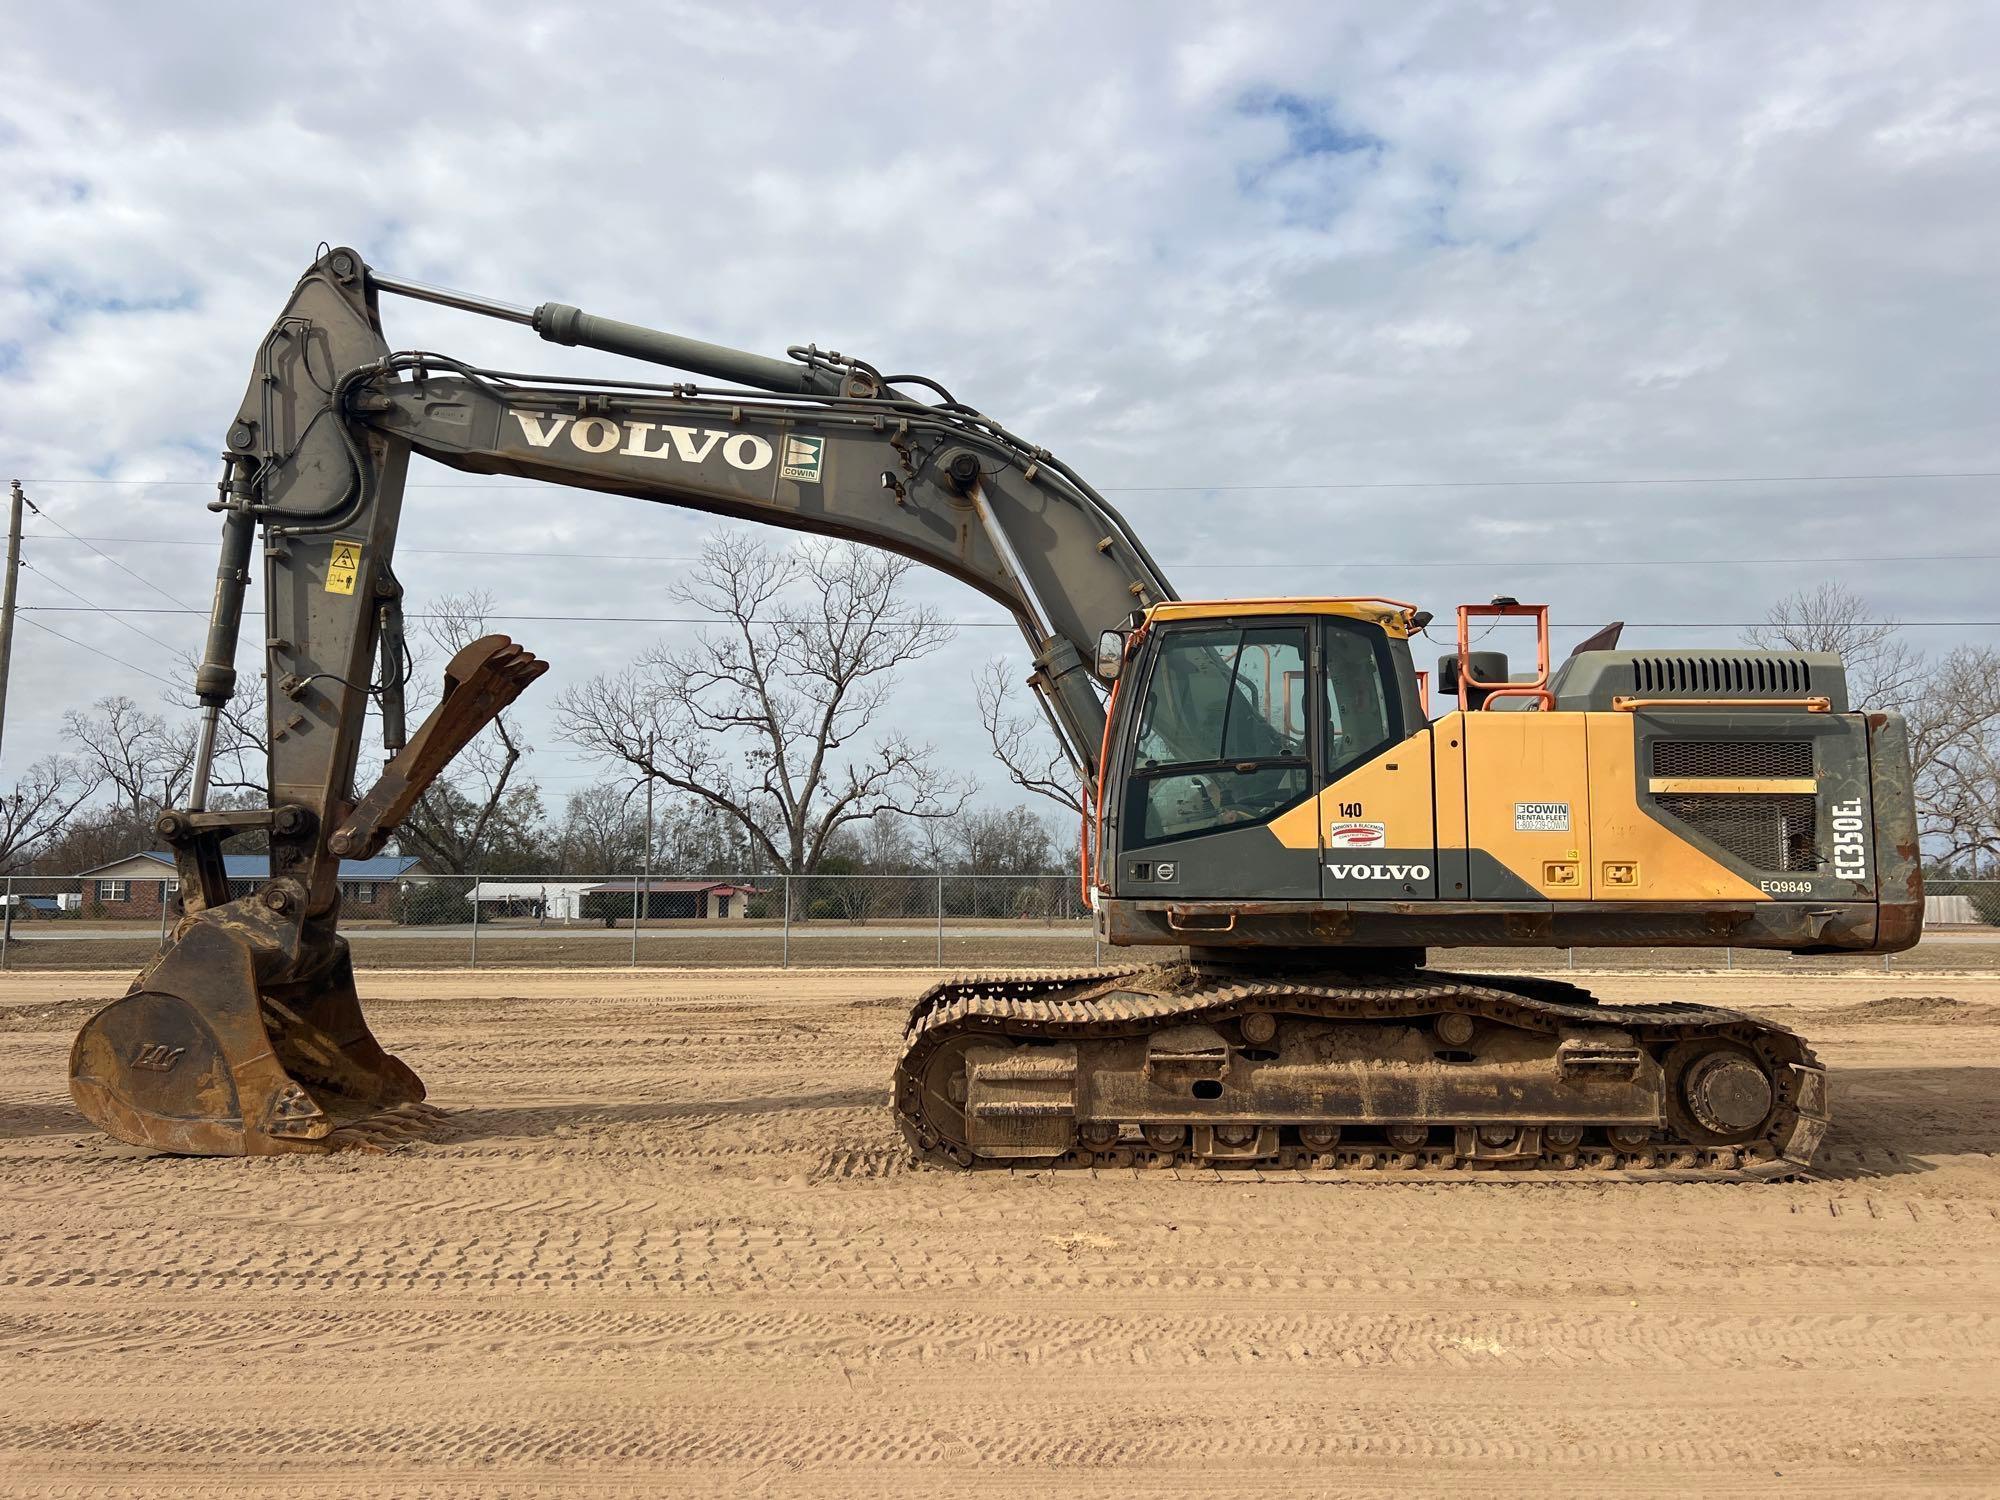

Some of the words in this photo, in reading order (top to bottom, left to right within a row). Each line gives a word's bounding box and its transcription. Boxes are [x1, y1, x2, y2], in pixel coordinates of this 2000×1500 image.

[509, 409, 773, 471] VOLVO
[784, 467, 816, 479] COWIN
[1339, 802, 1362, 818] 140
[1526, 805, 1567, 814] COWIN
[1358, 823, 1384, 831] BLACKMON
[1832, 797, 1865, 879] EC350EL
[1326, 864, 1430, 880] VOLVO
[1761, 881, 1812, 893] EQ9849
